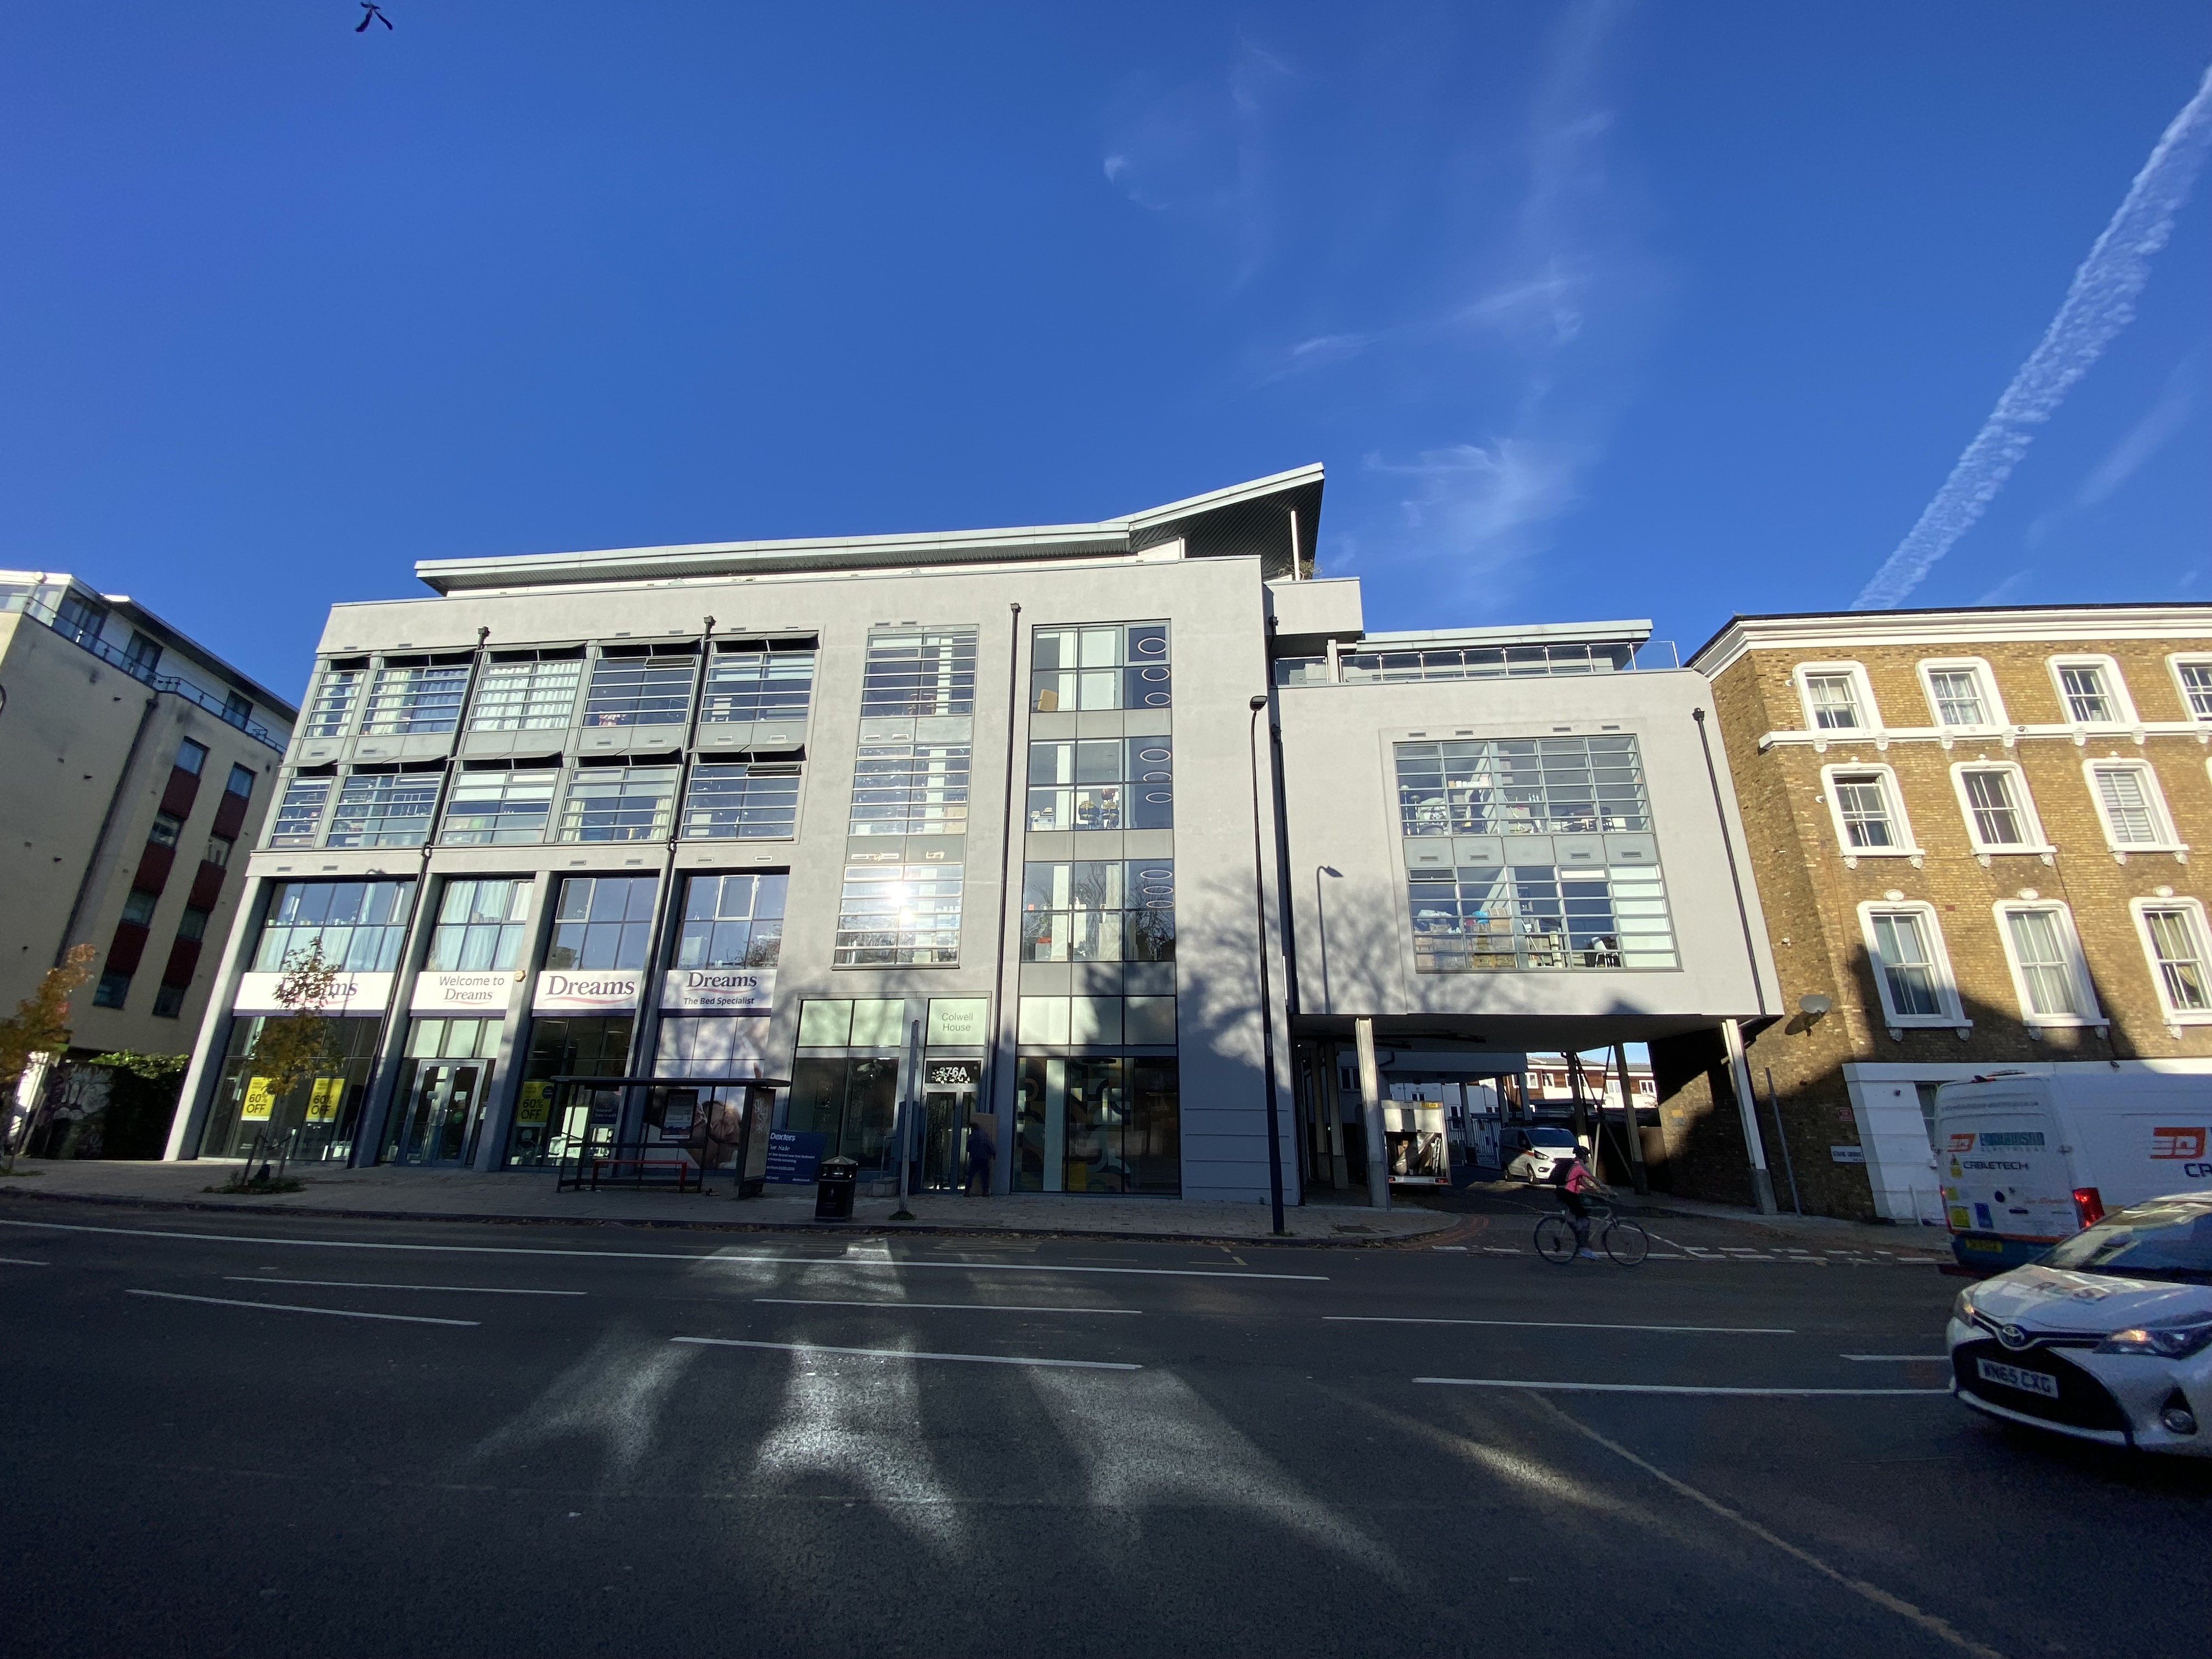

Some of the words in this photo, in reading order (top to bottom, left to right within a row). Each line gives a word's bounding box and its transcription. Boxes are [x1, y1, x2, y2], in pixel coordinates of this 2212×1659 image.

[439, 975, 490, 985] Welcome
[493, 977, 504, 985] to
[686, 972, 758, 987] Dreams
[546, 975, 635, 995] Dreams
[443, 988, 493, 1000] Dreams
[717, 997, 755, 1006] Specialist
[941, 1012, 973, 1021] Colwell
[943, 1023, 971, 1031] House
[249, 1094, 268, 1103] 60%
[313, 1094, 334, 1104] 60%
[246, 1104, 266, 1114] OFF
[522, 1099, 545, 1109] 60%
[311, 1105, 331, 1115] OFF
[521, 1109, 543, 1119] OFF
[770, 1132, 795, 1141] Dexters
